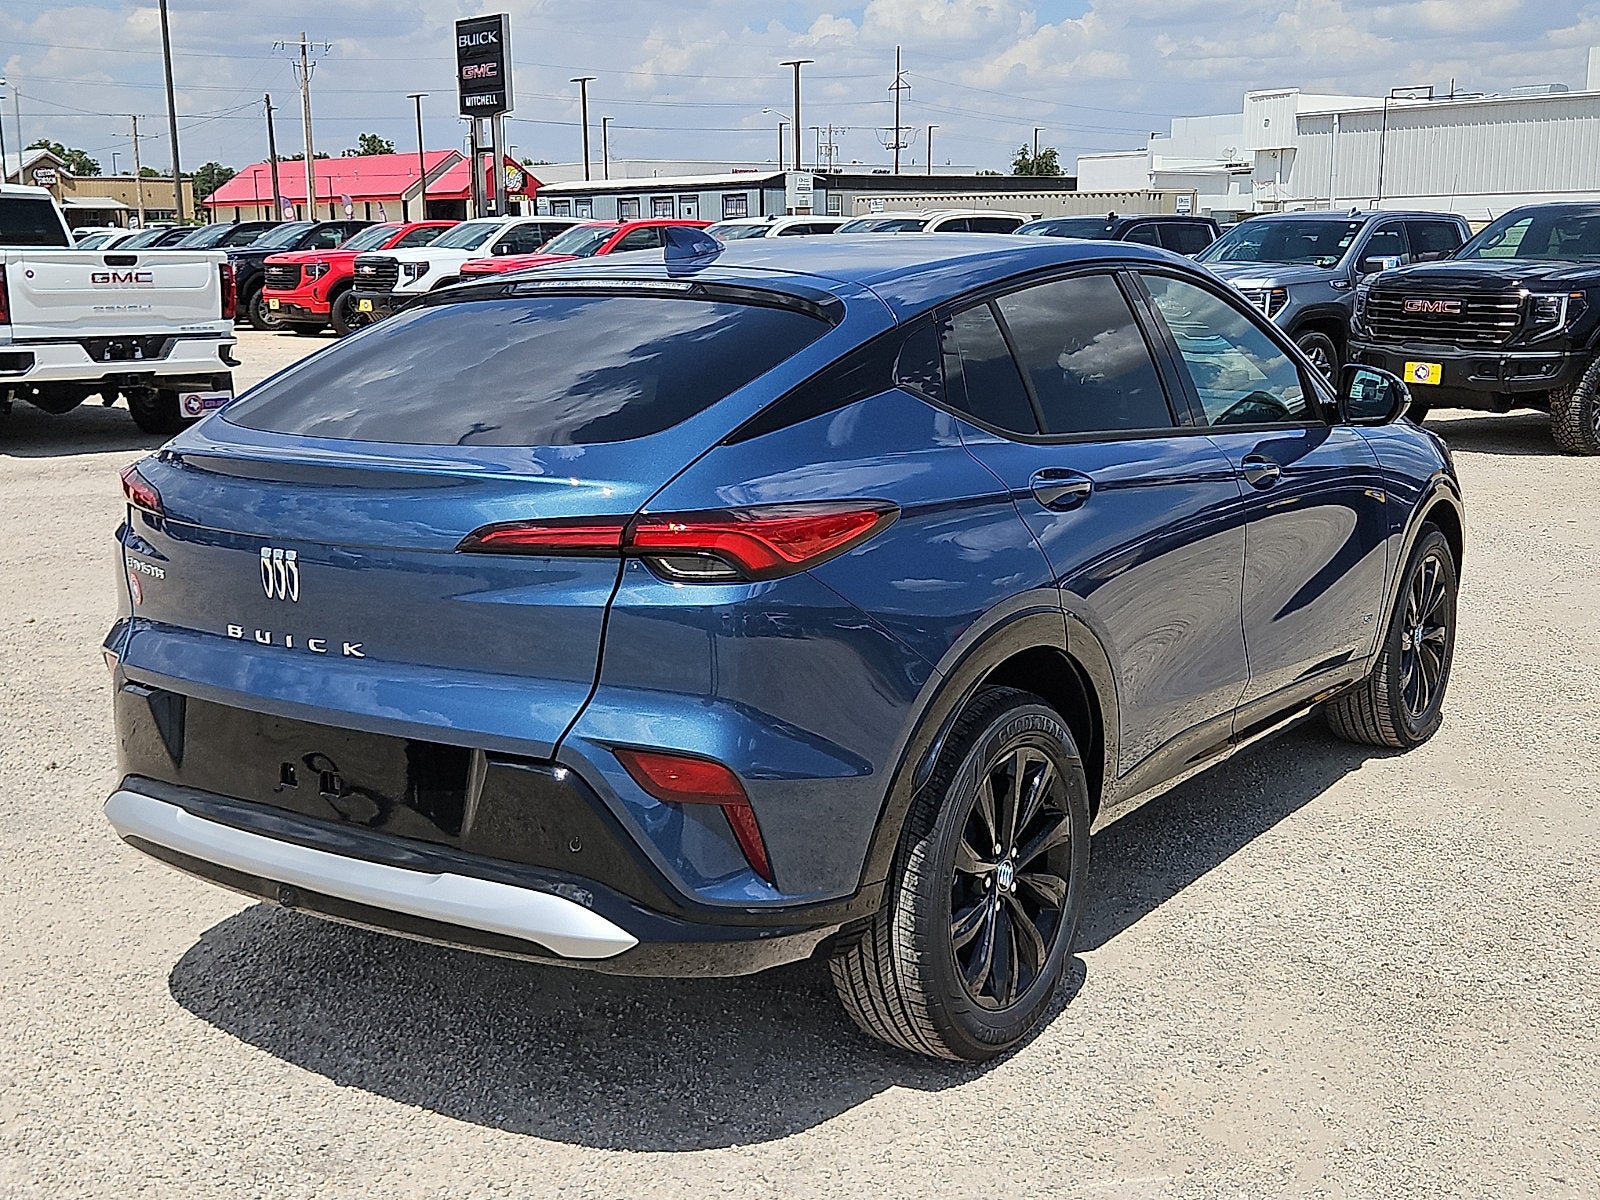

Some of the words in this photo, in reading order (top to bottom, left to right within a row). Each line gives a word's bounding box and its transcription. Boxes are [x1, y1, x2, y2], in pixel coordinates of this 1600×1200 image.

[458, 30, 499, 47] BUICK
[462, 62, 497, 79] GMC
[465, 94, 498, 106] MITCHELL
[91, 272, 153, 284] GMC
[1404, 299, 1461, 314] GMC
[226, 623, 366, 658] BUICK
